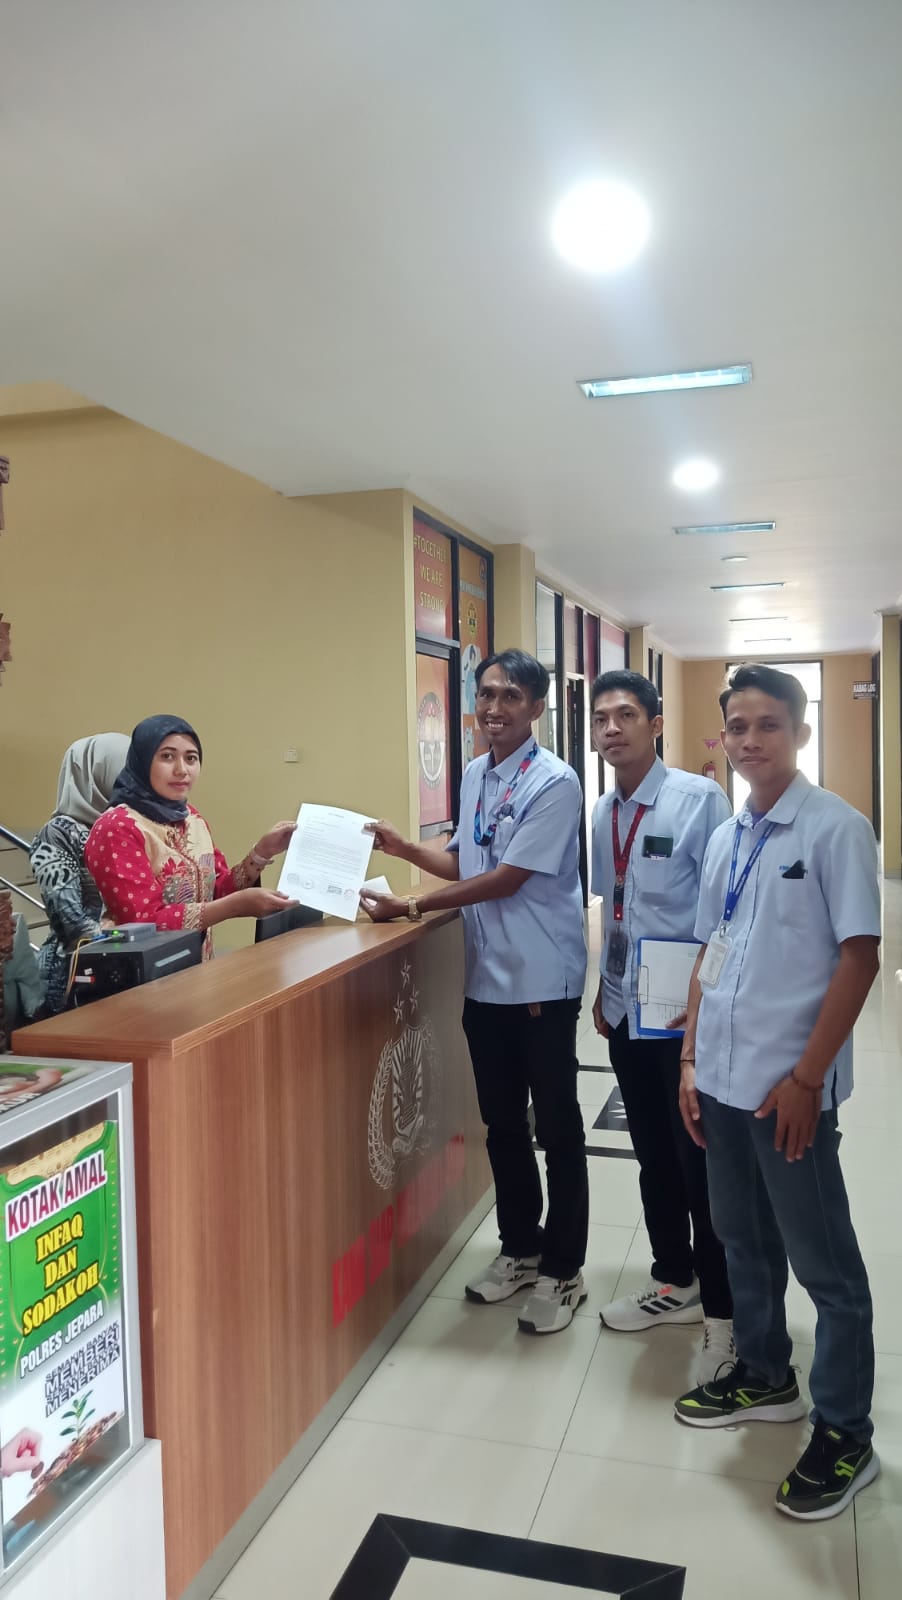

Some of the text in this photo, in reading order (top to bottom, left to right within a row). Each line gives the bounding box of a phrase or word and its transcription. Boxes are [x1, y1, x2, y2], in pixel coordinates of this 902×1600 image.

[421, 564, 431, 583] WE
[7, 1152, 106, 1238] KOTAK AMAL
[36, 1213, 84, 1262] INFAQ
[44, 1247, 78, 1290] DAN
[22, 1261, 99, 1336] SODAKOH
[20, 1300, 104, 1379] POLRES JEPARA
[45, 1326, 120, 1398] MEMBERI
[45, 1348, 120, 1418] MENERIMA
